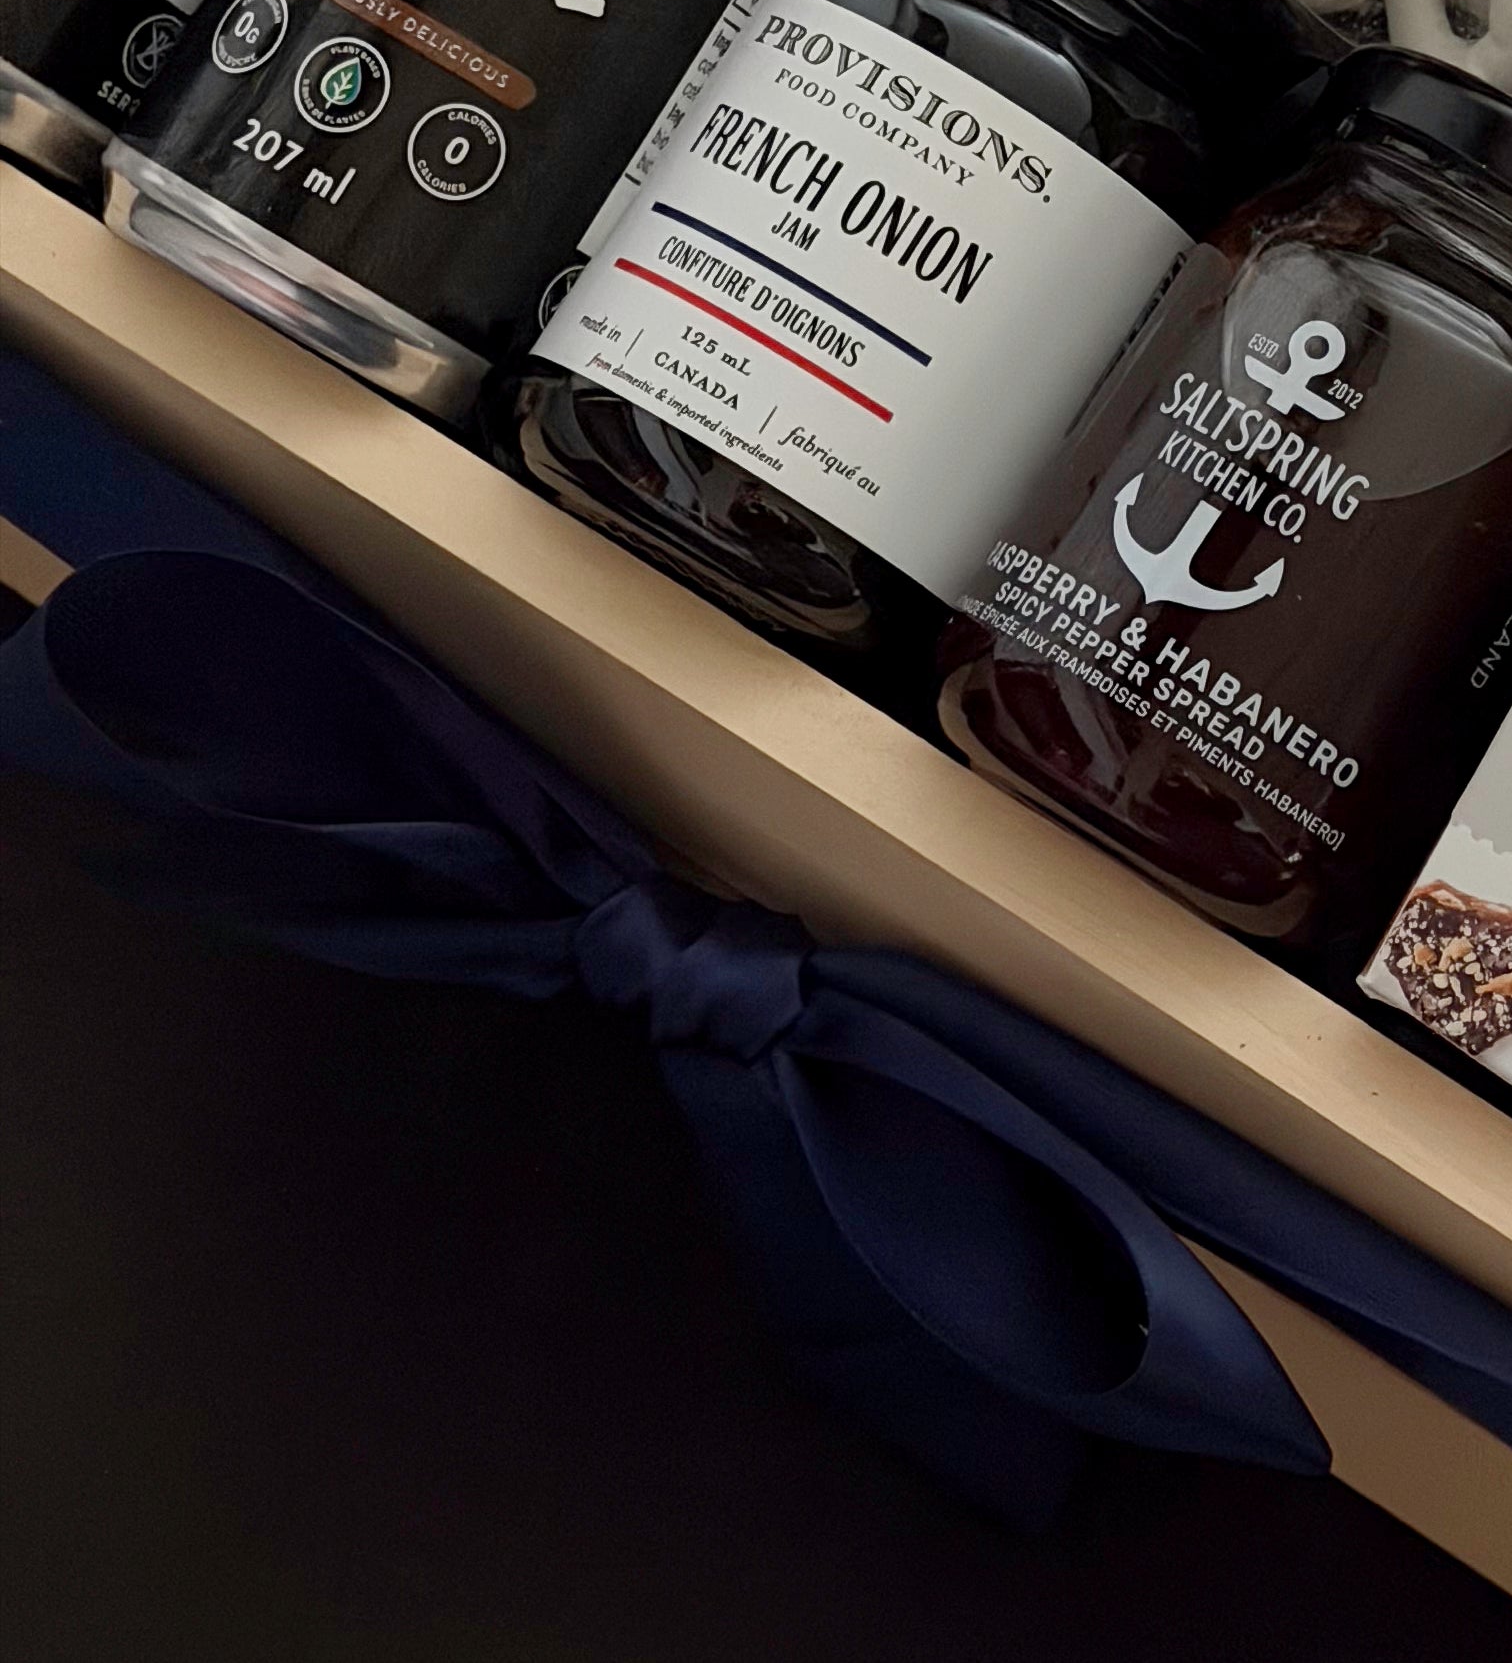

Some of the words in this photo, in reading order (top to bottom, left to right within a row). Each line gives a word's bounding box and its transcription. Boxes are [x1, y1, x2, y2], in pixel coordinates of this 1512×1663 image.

[402, 17, 510, 89] DELICIOUS
[232, 117, 305, 172] 207
[302, 167, 357, 205] ml
[444, 136, 470, 165] 0
[447, 111, 498, 146] CALORIES
[774, 67, 837, 108] FOOD
[842, 101, 976, 187] COMPANY
[416, 159, 467, 194] CALORIES
[689, 103, 844, 213] FRENCH
[839, 180, 994, 305] ONION
[770, 210, 821, 252] JAM
[579, 314, 610, 337] made
[606, 324, 622, 343] in
[657, 235, 756, 303] CONFITURE
[750, 285, 866, 369] D'OIGNONS
[654, 351, 740, 411] CANADA
[680, 324, 720, 356] 125
[720, 352, 752, 377] mL
[1247, 333, 1280, 359] ESTD
[584, 351, 613, 374] from
[612, 363, 656, 397] domestic
[655, 387, 669, 402] &
[667, 393, 722, 434] imported
[718, 426, 785, 473] ingredients
[1327, 379, 1364, 410] 2012
[778, 426, 861, 481] fabriqué
[856, 471, 882, 497] au
[1159, 372, 1370, 521] SALTSPRING
[1157, 430, 1268, 512] KITCHEN
[1263, 494, 1307, 544] CO.
[995, 581, 1054, 623] SPICY
[1050, 612, 1151, 687] PEPPER
[1153, 677, 1266, 763] SPREAD
[1016, 627, 1050, 654] AUX
[1045, 644, 1151, 719] FRAMBOISES
[1150, 709, 1180, 734] ET
[1175, 725, 1256, 788] PIMENTS
[1120, 616, 1149, 652] &
[1155, 636, 1361, 790] HABANERO
